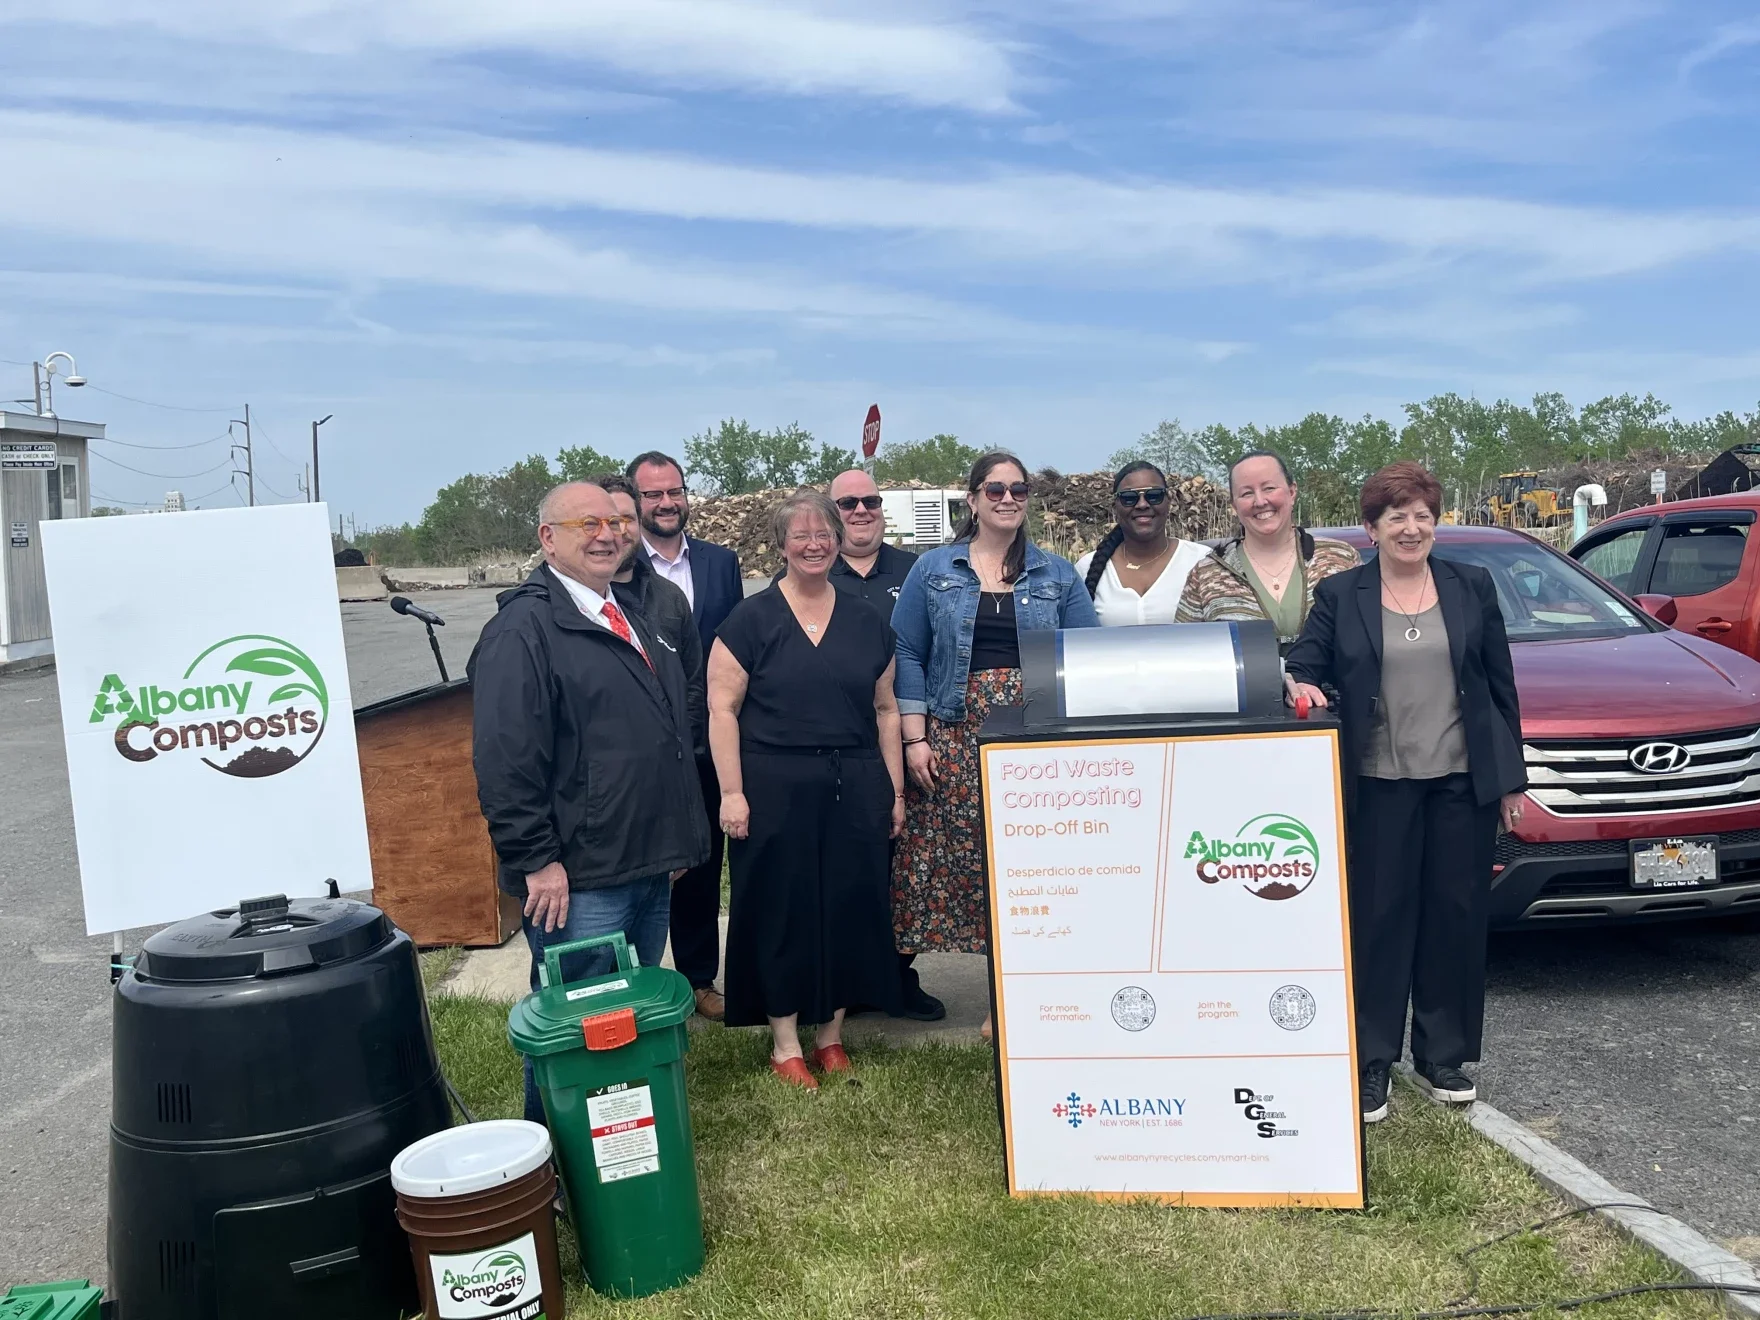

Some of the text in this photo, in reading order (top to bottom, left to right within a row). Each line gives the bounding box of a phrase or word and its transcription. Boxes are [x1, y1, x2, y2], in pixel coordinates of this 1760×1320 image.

[863, 420, 880, 445] STOP
[89, 673, 253, 724] Albany
[114, 706, 319, 763] Composts
[1001, 758, 1135, 780] Food Waste
[1002, 785, 1142, 810] Composting
[1004, 819, 1109, 838] Drop-Off Bin
[1183, 830, 1275, 861] Albany
[1007, 864, 1141, 878] Desperdicio de comida
[1196, 858, 1313, 884] Composts
[1009, 905, 1050, 916] 食物浪費
[1040, 1004, 1054, 1012] For
[1198, 1000, 1232, 1009] Join the
[607, 1083, 621, 1094] GOES
[1099, 1098, 1186, 1116] ALBANY
[611, 1120, 638, 1133] STAYS OUT
[1099, 1119, 1183, 1127] NEW YORK EST. 1686
[442, 1269, 499, 1288] Albany
[449, 1274, 524, 1302] Composts
[520, 1300, 540, 1320] ONLY
